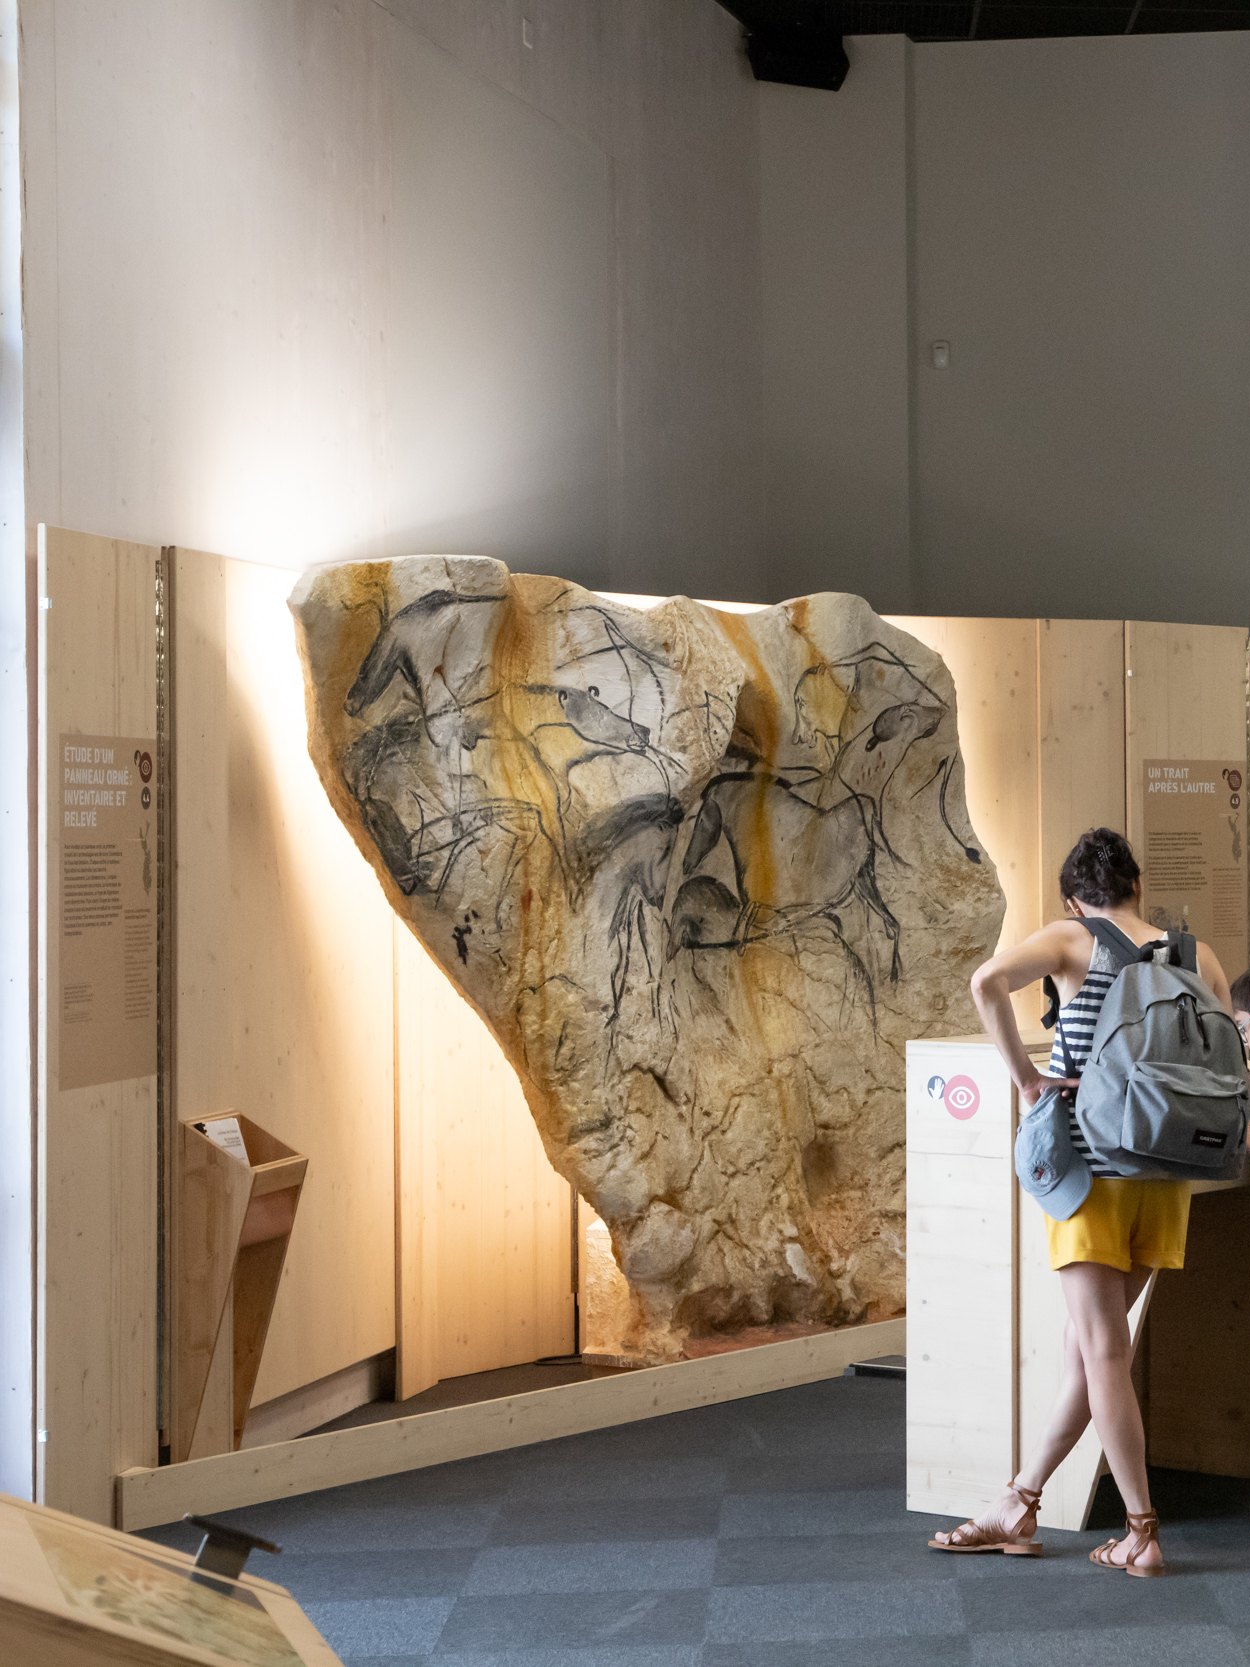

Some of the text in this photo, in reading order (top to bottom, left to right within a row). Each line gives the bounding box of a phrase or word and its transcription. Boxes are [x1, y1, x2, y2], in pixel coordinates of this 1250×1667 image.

[64, 742, 114, 764] ÉTUDE D'UN
[64, 768, 105, 785] PANNEAU
[1148, 767, 1190, 779] UN TRAIT
[1148, 779, 1216, 794] APRÈS L'AUTRE
[64, 789, 127, 806] INVENTAIRE ET
[64, 807, 97, 827] RELEVÉ
